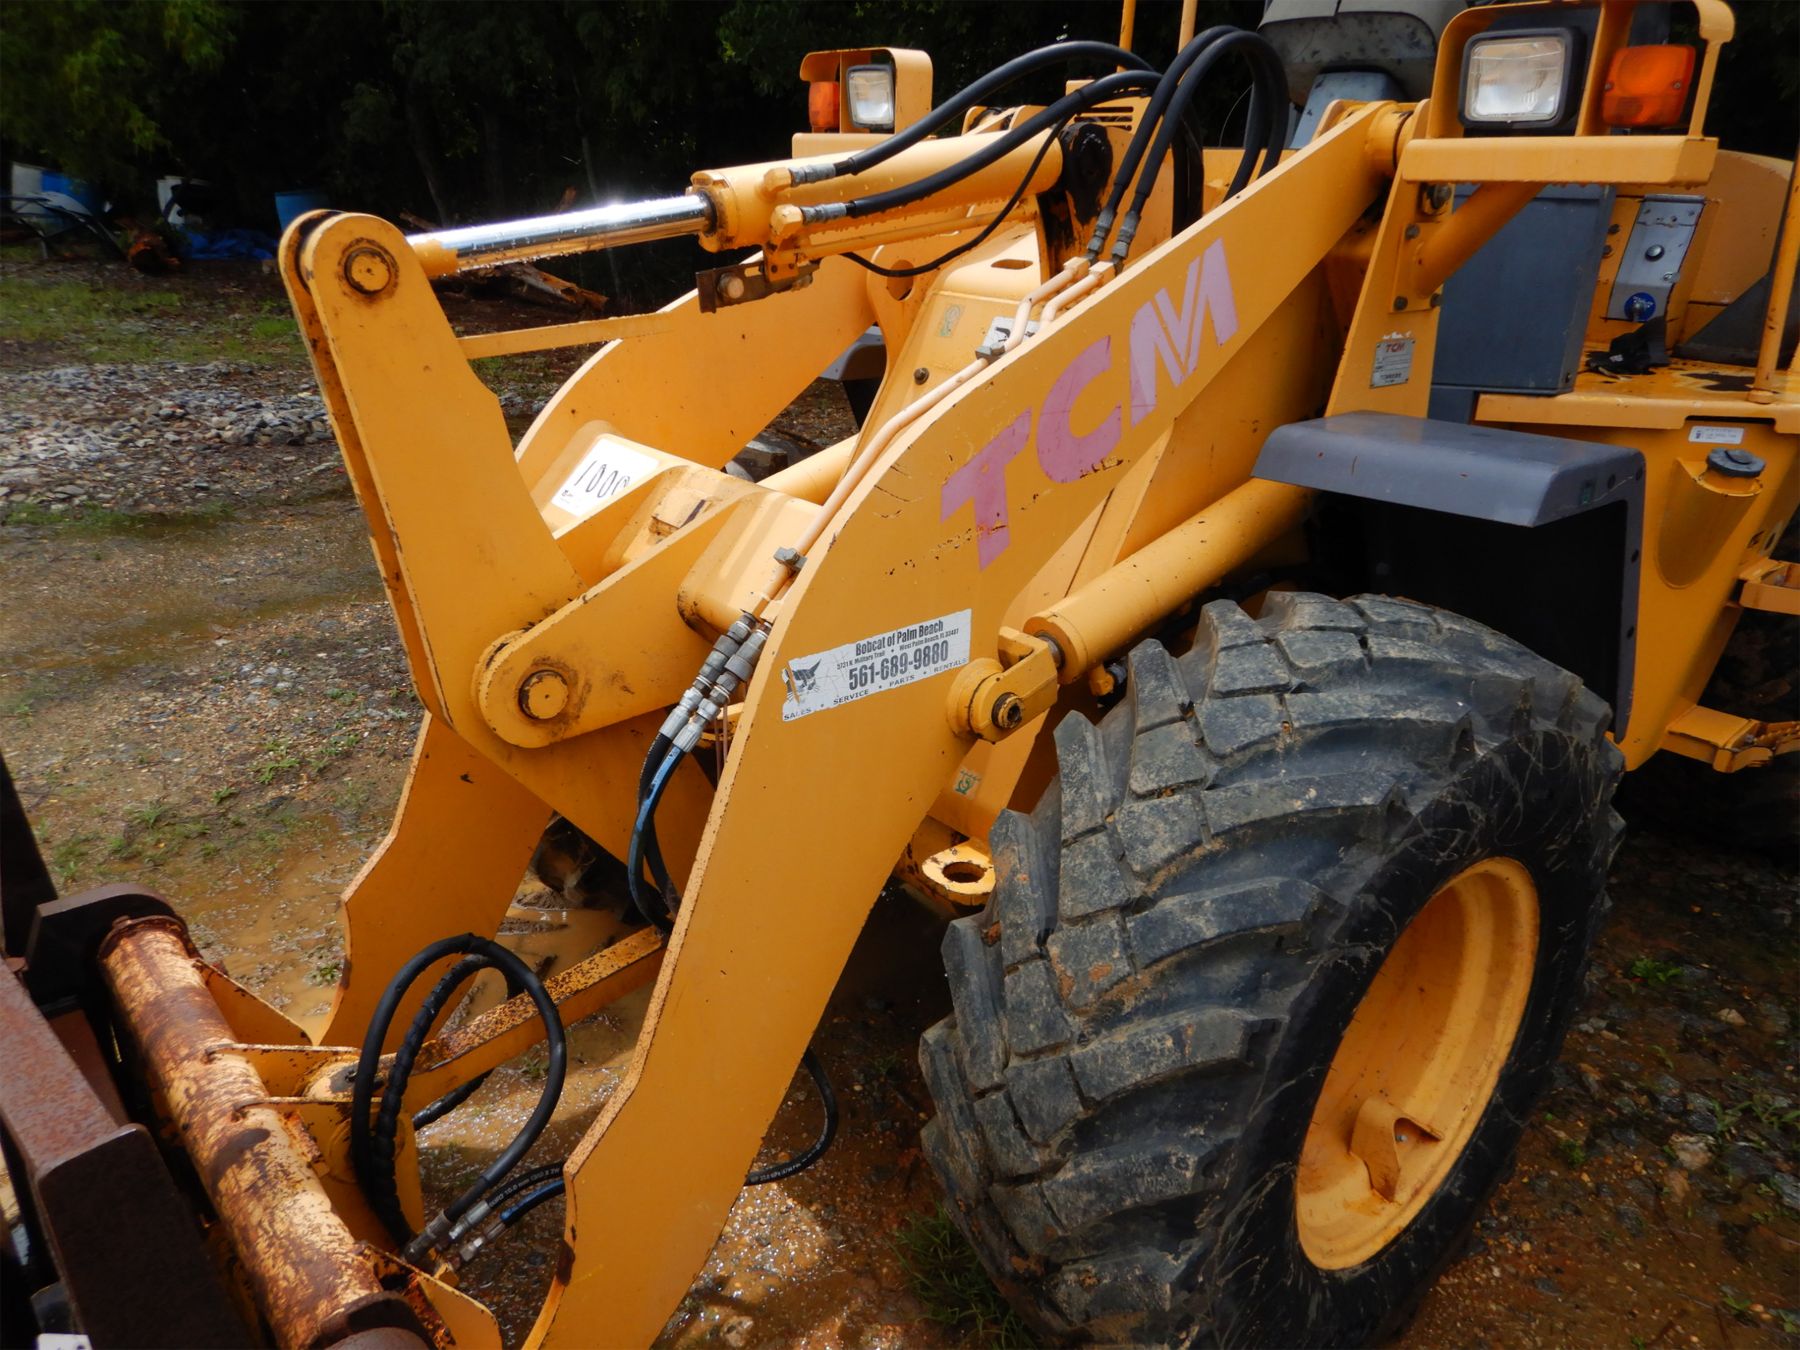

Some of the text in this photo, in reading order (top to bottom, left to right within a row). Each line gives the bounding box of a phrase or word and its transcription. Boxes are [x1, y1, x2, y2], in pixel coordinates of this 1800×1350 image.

[940, 237, 1240, 573] TCM
[856, 620, 944, 656] Bobcat of Palm Beach
[912, 639, 924, 647] Palm
[784, 658, 967, 721] SALES SERVICE PARTS RENTALS
[849, 640, 949, 691] 561-689-9880
